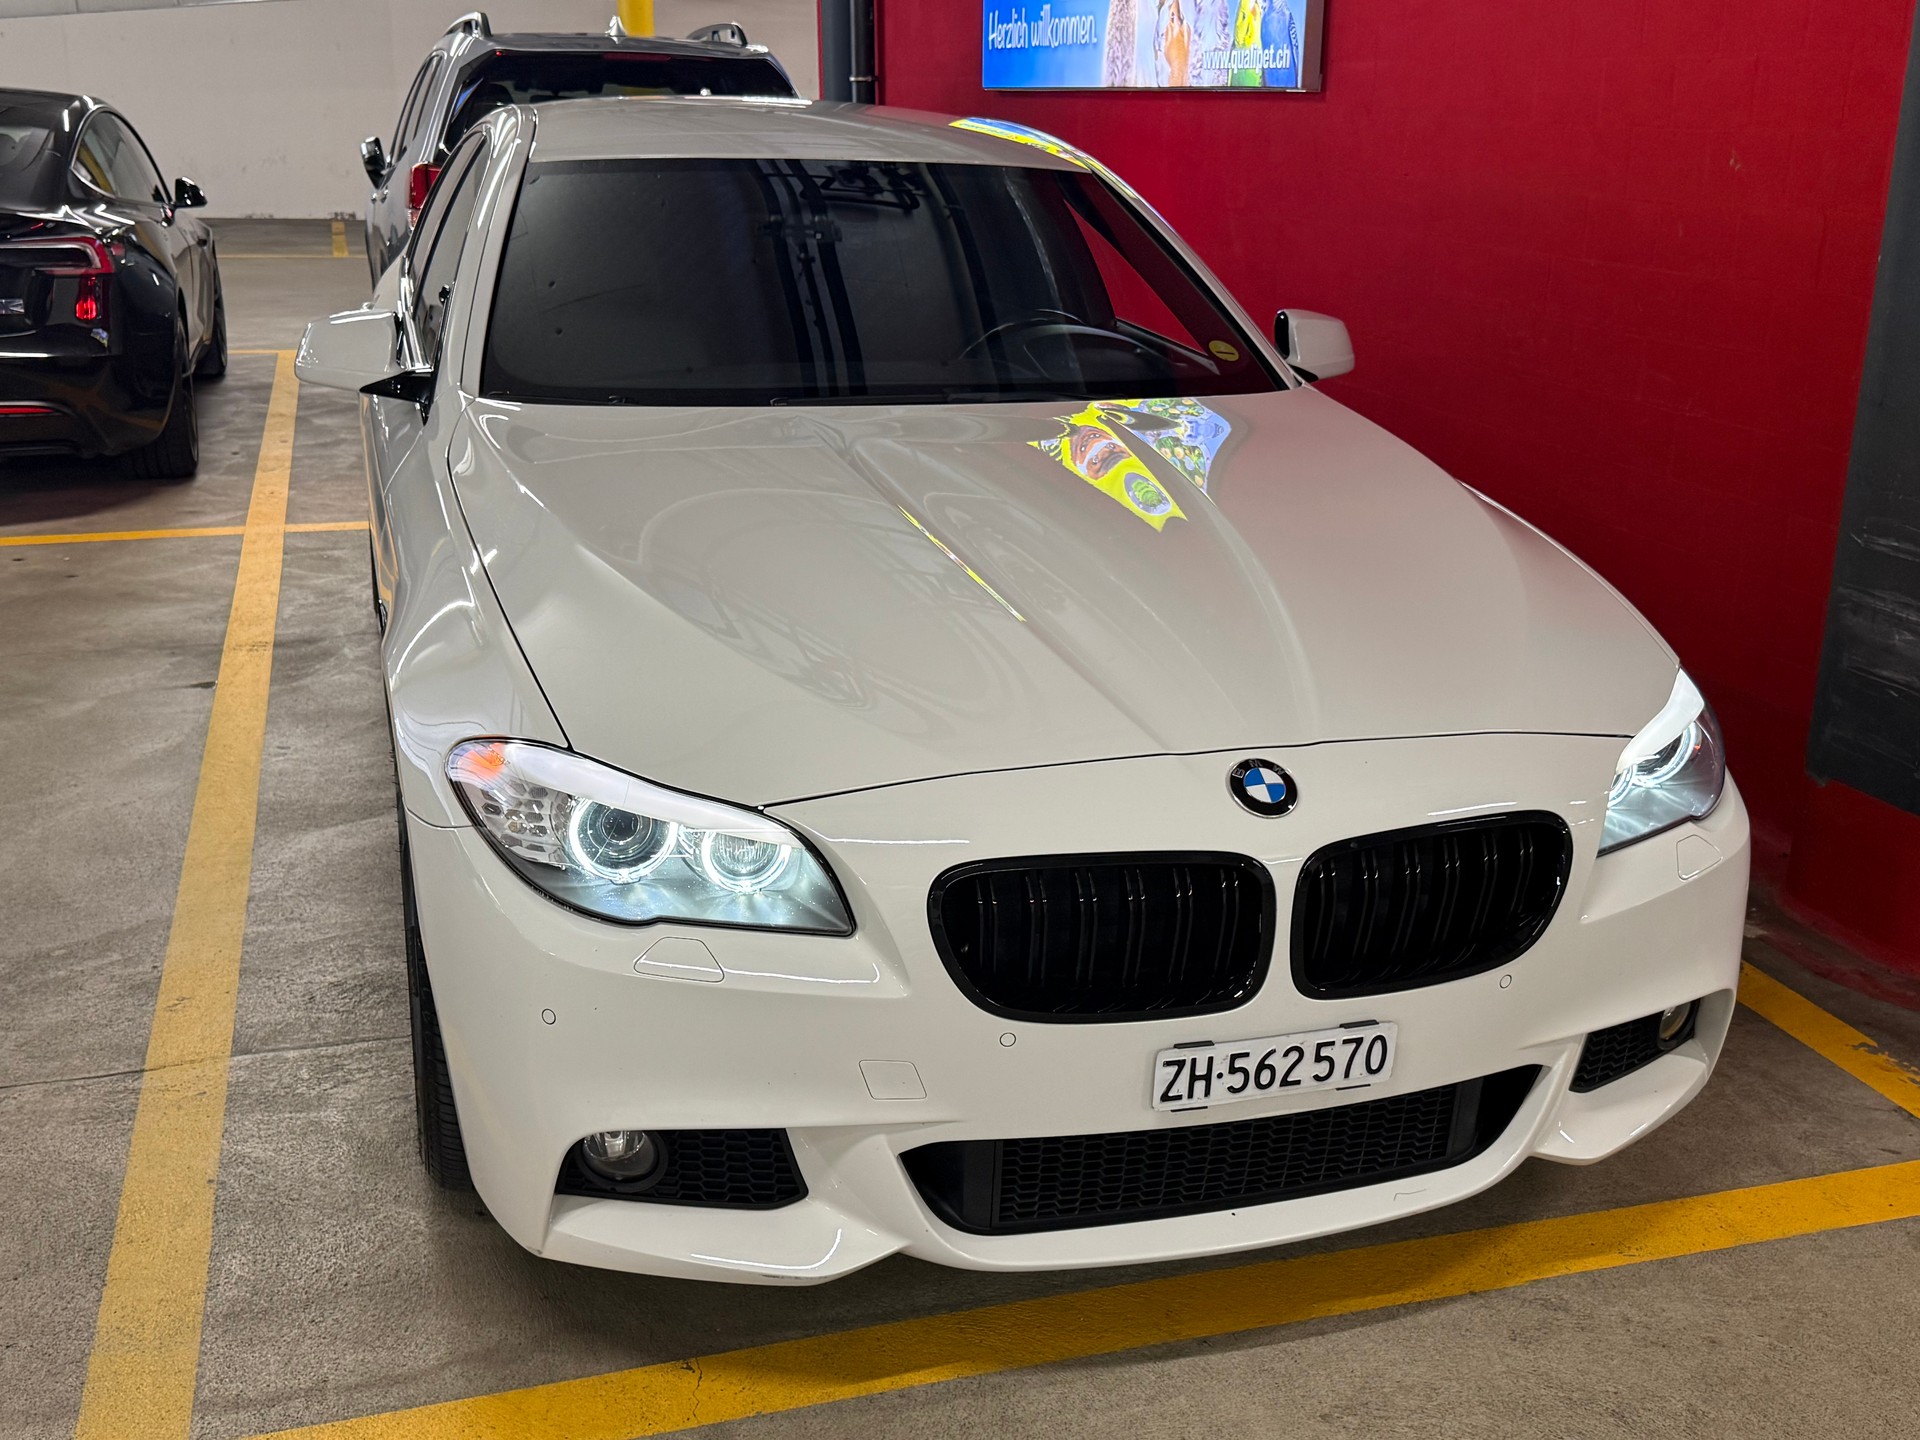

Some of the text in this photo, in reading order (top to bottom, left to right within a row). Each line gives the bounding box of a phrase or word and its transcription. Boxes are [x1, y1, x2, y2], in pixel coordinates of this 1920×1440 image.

[988, 4, 1097, 50] Herzlich willkommen.
[1202, 43, 1290, 74] www.qualipet.ch
[1231, 759, 1285, 778] BMW
